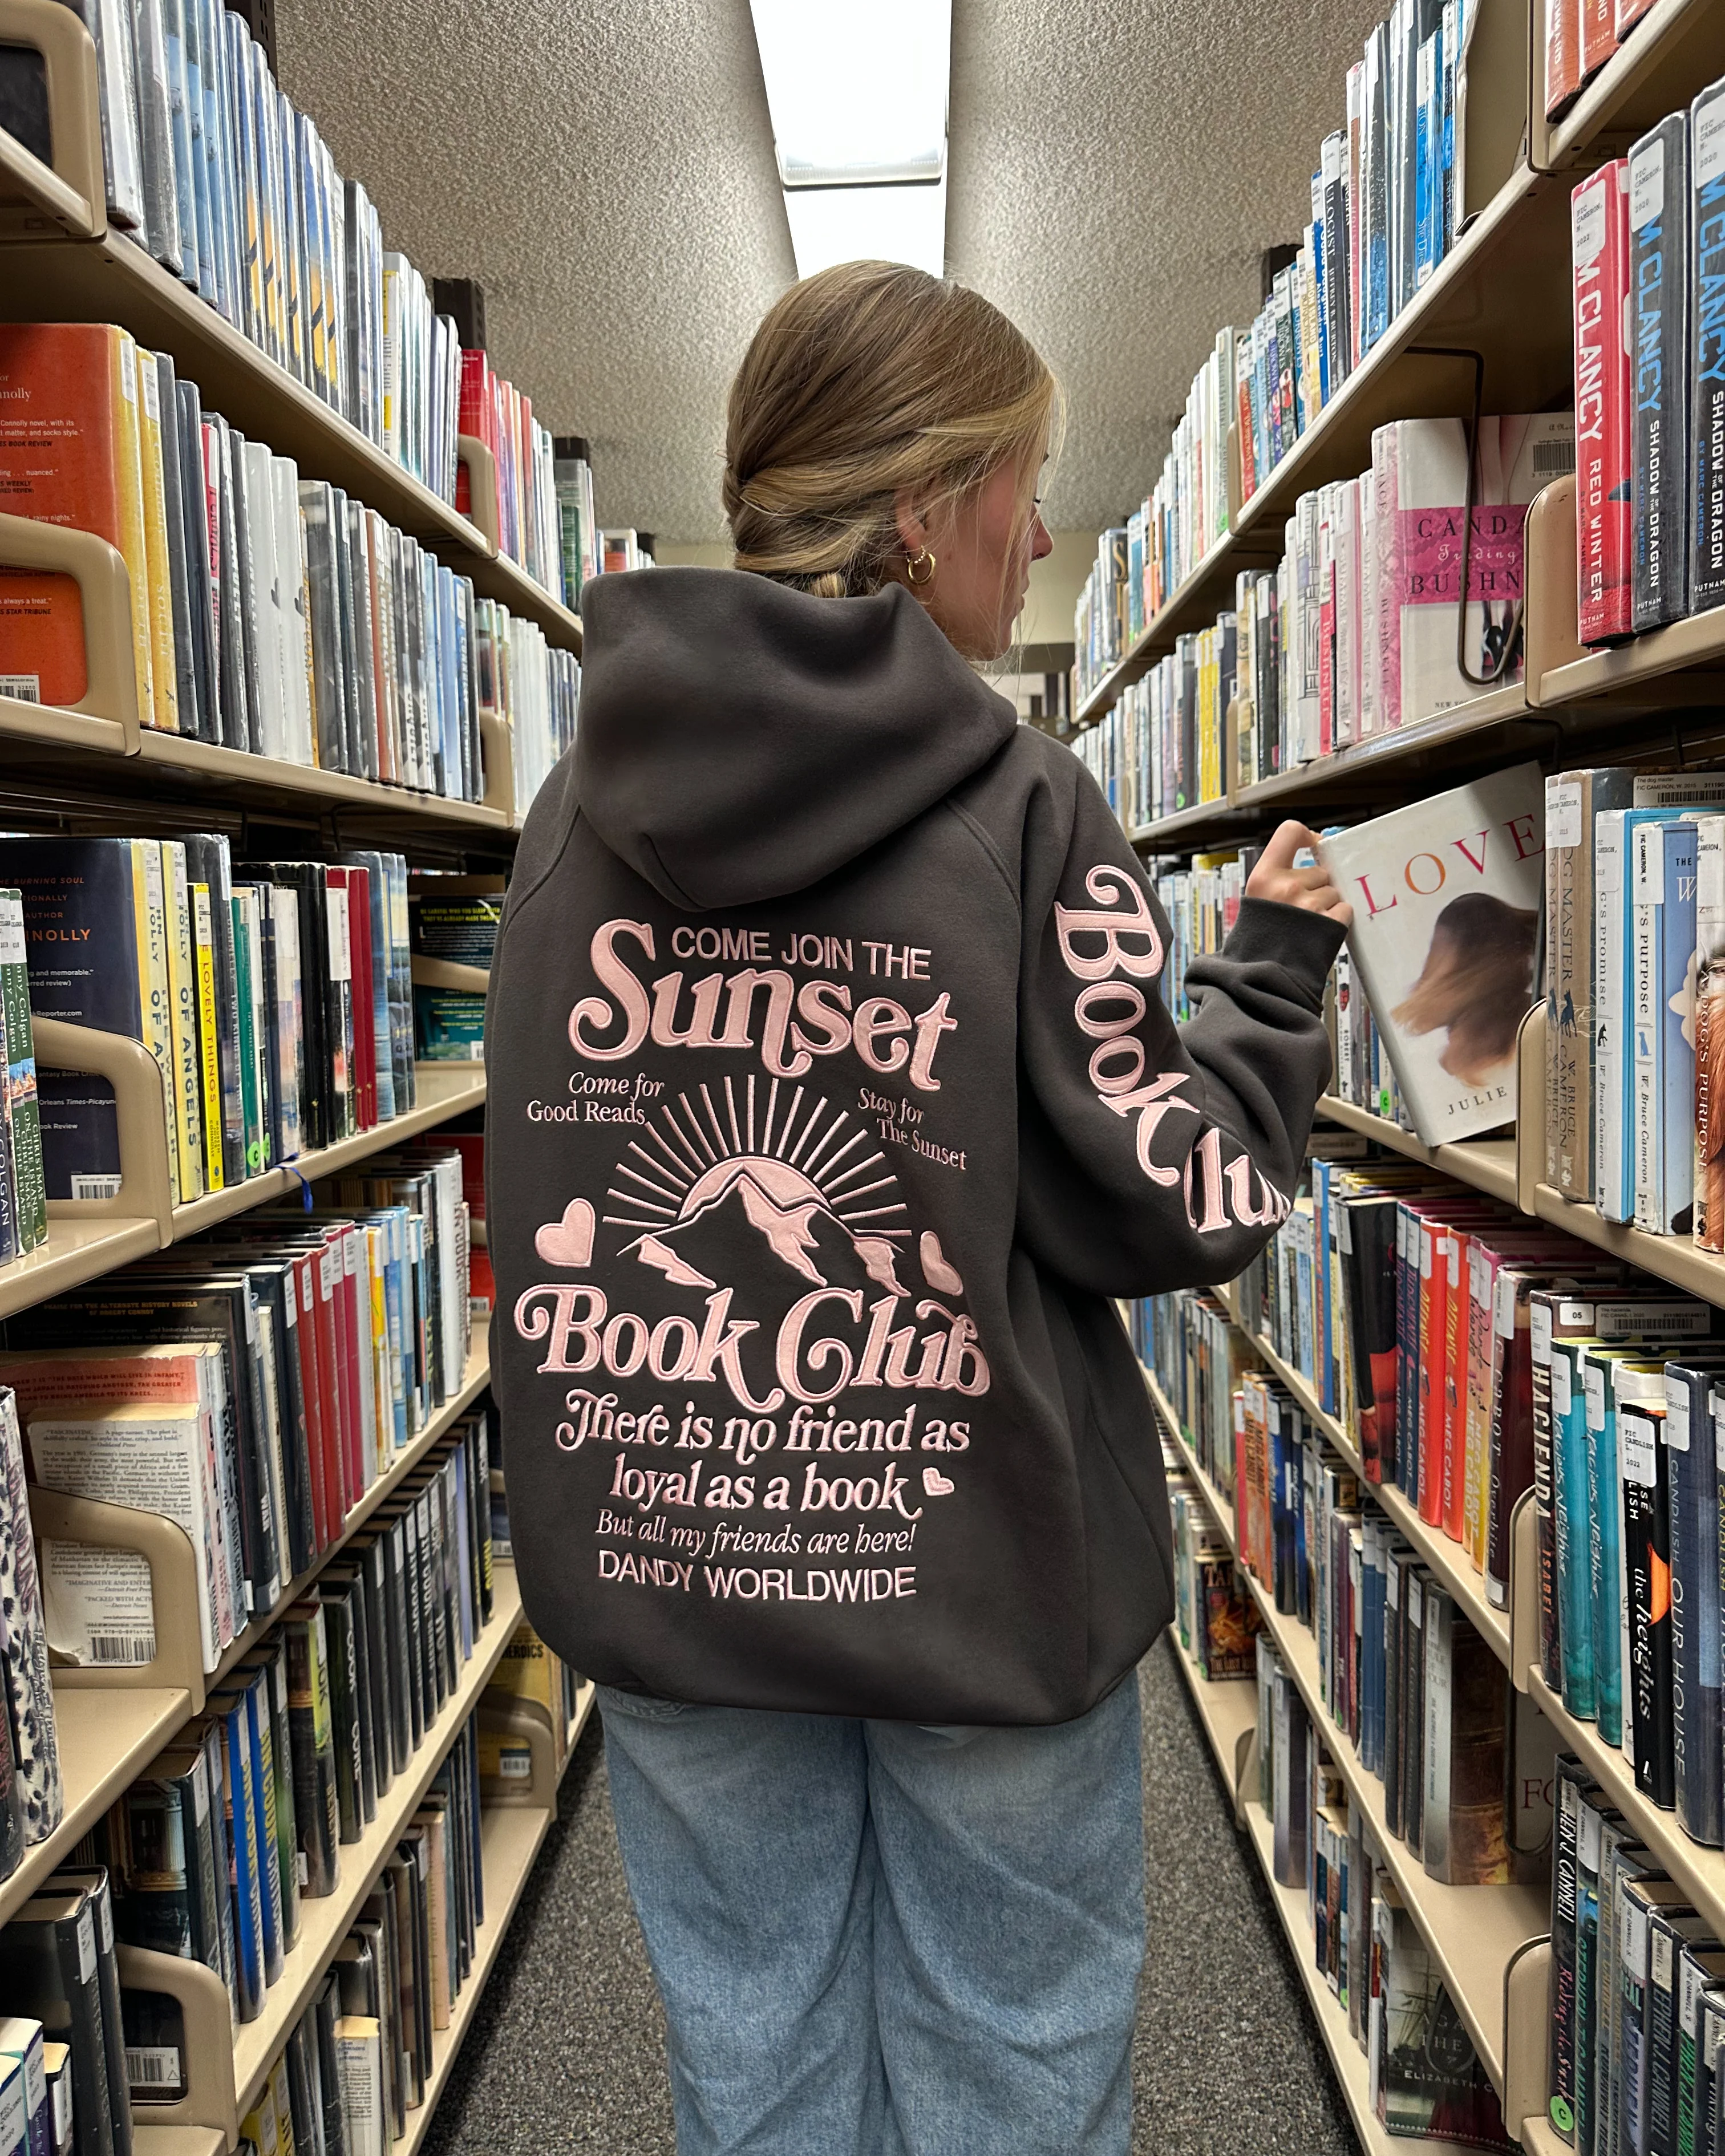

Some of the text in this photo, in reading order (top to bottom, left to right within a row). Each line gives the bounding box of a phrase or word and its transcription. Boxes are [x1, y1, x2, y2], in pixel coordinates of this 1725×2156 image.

[1699, 151, 1718, 168] 2020
[1635, 198, 1649, 214] 2020
[1576, 233, 1590, 248] 2022
[1699, 211, 1725, 382] CLANCY
[1578, 290, 1602, 441] CLANCY
[1638, 252, 1662, 412] CLANCY
[1650, 420, 1659, 495] SHADOW
[1712, 391, 1724, 470] SHADOW
[1438, 544, 1517, 564] Trding
[1590, 458, 1602, 603] RED WINTER
[1650, 513, 1659, 587] DRAGON
[1711, 489, 1723, 569] DRAGON
[1637, 597, 1661, 610] PUTNAM
[1354, 812, 1545, 918] LOVE
[25, 928, 91, 942] NOLLY
[672, 926, 932, 981] COME JOIN THE
[1561, 887, 1574, 982] MASTER
[203, 962, 218, 1103] LOVELY THINGS
[568, 918, 958, 1092] Sunset
[1054, 864, 1201, 1188] Book
[1698, 995, 1709, 1062] DOG'S
[180, 987, 197, 1146] OF ANGELS
[569, 1072, 665, 1103] Come for
[1558, 1044, 1568, 1149] CAMERON
[527, 1100, 646, 1125] Good Reads
[858, 1088, 924, 1125] Stay for
[1447, 1085, 1508, 1116] JULIE
[1567, 1086, 1576, 1138] BRUCE
[1698, 1073, 1709, 1175] PURPOSE
[877, 1118, 967, 1170] The Sunset
[513, 1283, 991, 1413] Book Club
[555, 1388, 970, 1465] There is no friend as
[1466, 1409, 1475, 1448] MEG
[1533, 1365, 1551, 1518] HACIENDA
[609, 1453, 923, 1520] loyal as a book
[1444, 1412, 1452, 1510] MEG CABOT
[1626, 1458, 1641, 1468] 2022
[596, 1509, 917, 1559] But all my friends are here!
[1628, 1481, 1639, 1521] LISH
[597, 1550, 917, 1603] DANDY WORLDWIDE
[1542, 1549, 1552, 1615] ISABEL
[1633, 1569, 1654, 1720] the heights
[1670, 1460, 1686, 1776] CANDLISH OUR HOUSE
[1557, 1859, 1576, 1923] CANNELL
[1404, 2069, 1477, 2089] ELIZABETH
